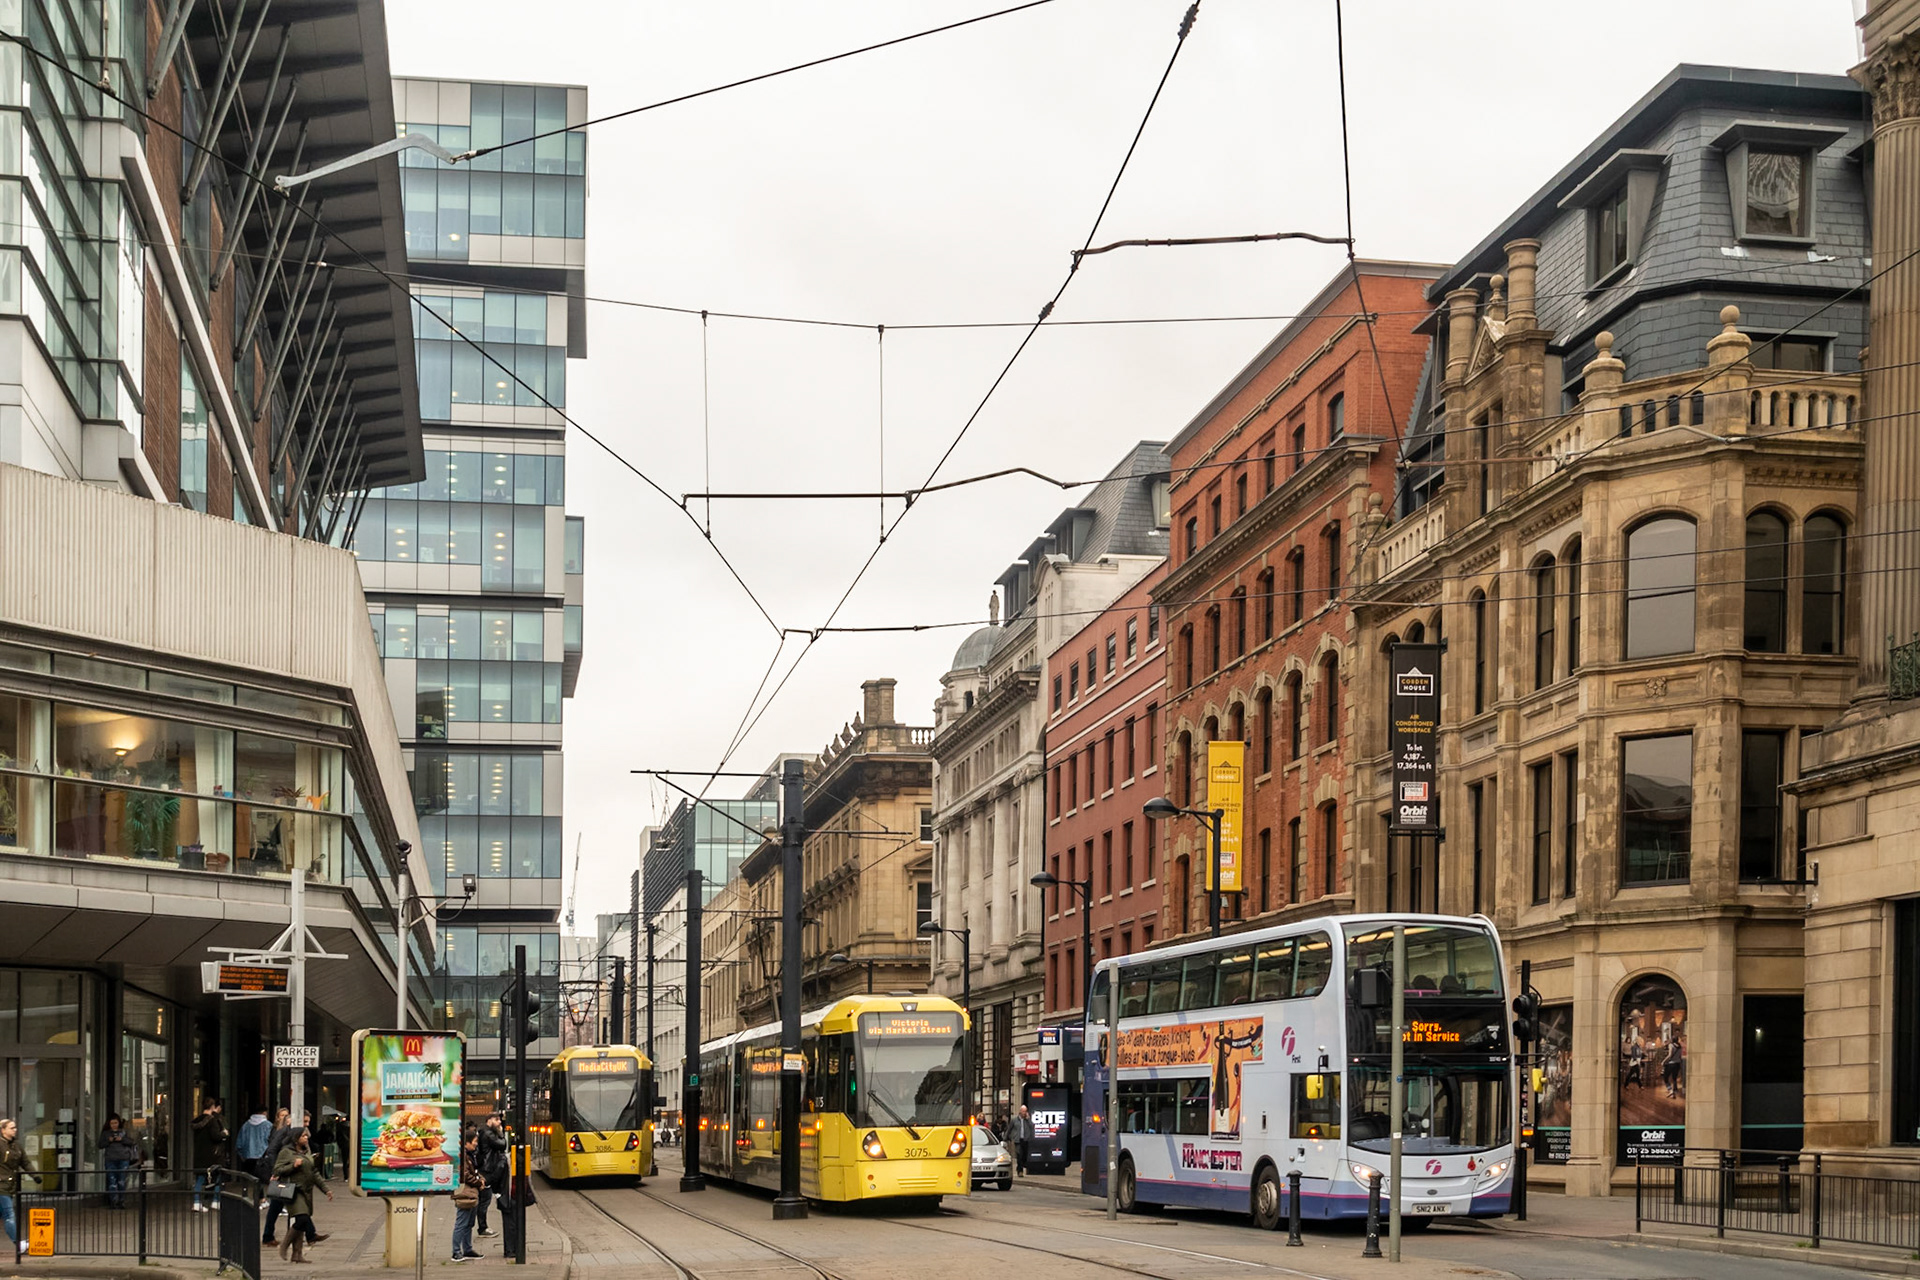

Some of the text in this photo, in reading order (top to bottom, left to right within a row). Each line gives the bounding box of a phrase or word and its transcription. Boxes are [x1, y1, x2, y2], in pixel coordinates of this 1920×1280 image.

[1403, 753, 1420, 761] 4,187
[1397, 762, 1432, 772] 17,364 sq ft
[1400, 805, 1428, 815] Orbit
[891, 1019, 929, 1027] Victoria
[1412, 1021, 1442, 1032] Sorry,
[868, 1026, 951, 1035] via Market Street
[1414, 1032, 1423, 1042] in
[1426, 1031, 1460, 1042] Service
[276, 1047, 317, 1056] PARKER
[277, 1057, 316, 1066] STREET
[579, 1060, 628, 1072] MediaCityUK
[386, 1072, 439, 1089] JAMAICAN
[1031, 1111, 1065, 1124] BITE
[1641, 1130, 1666, 1139] Orbit
